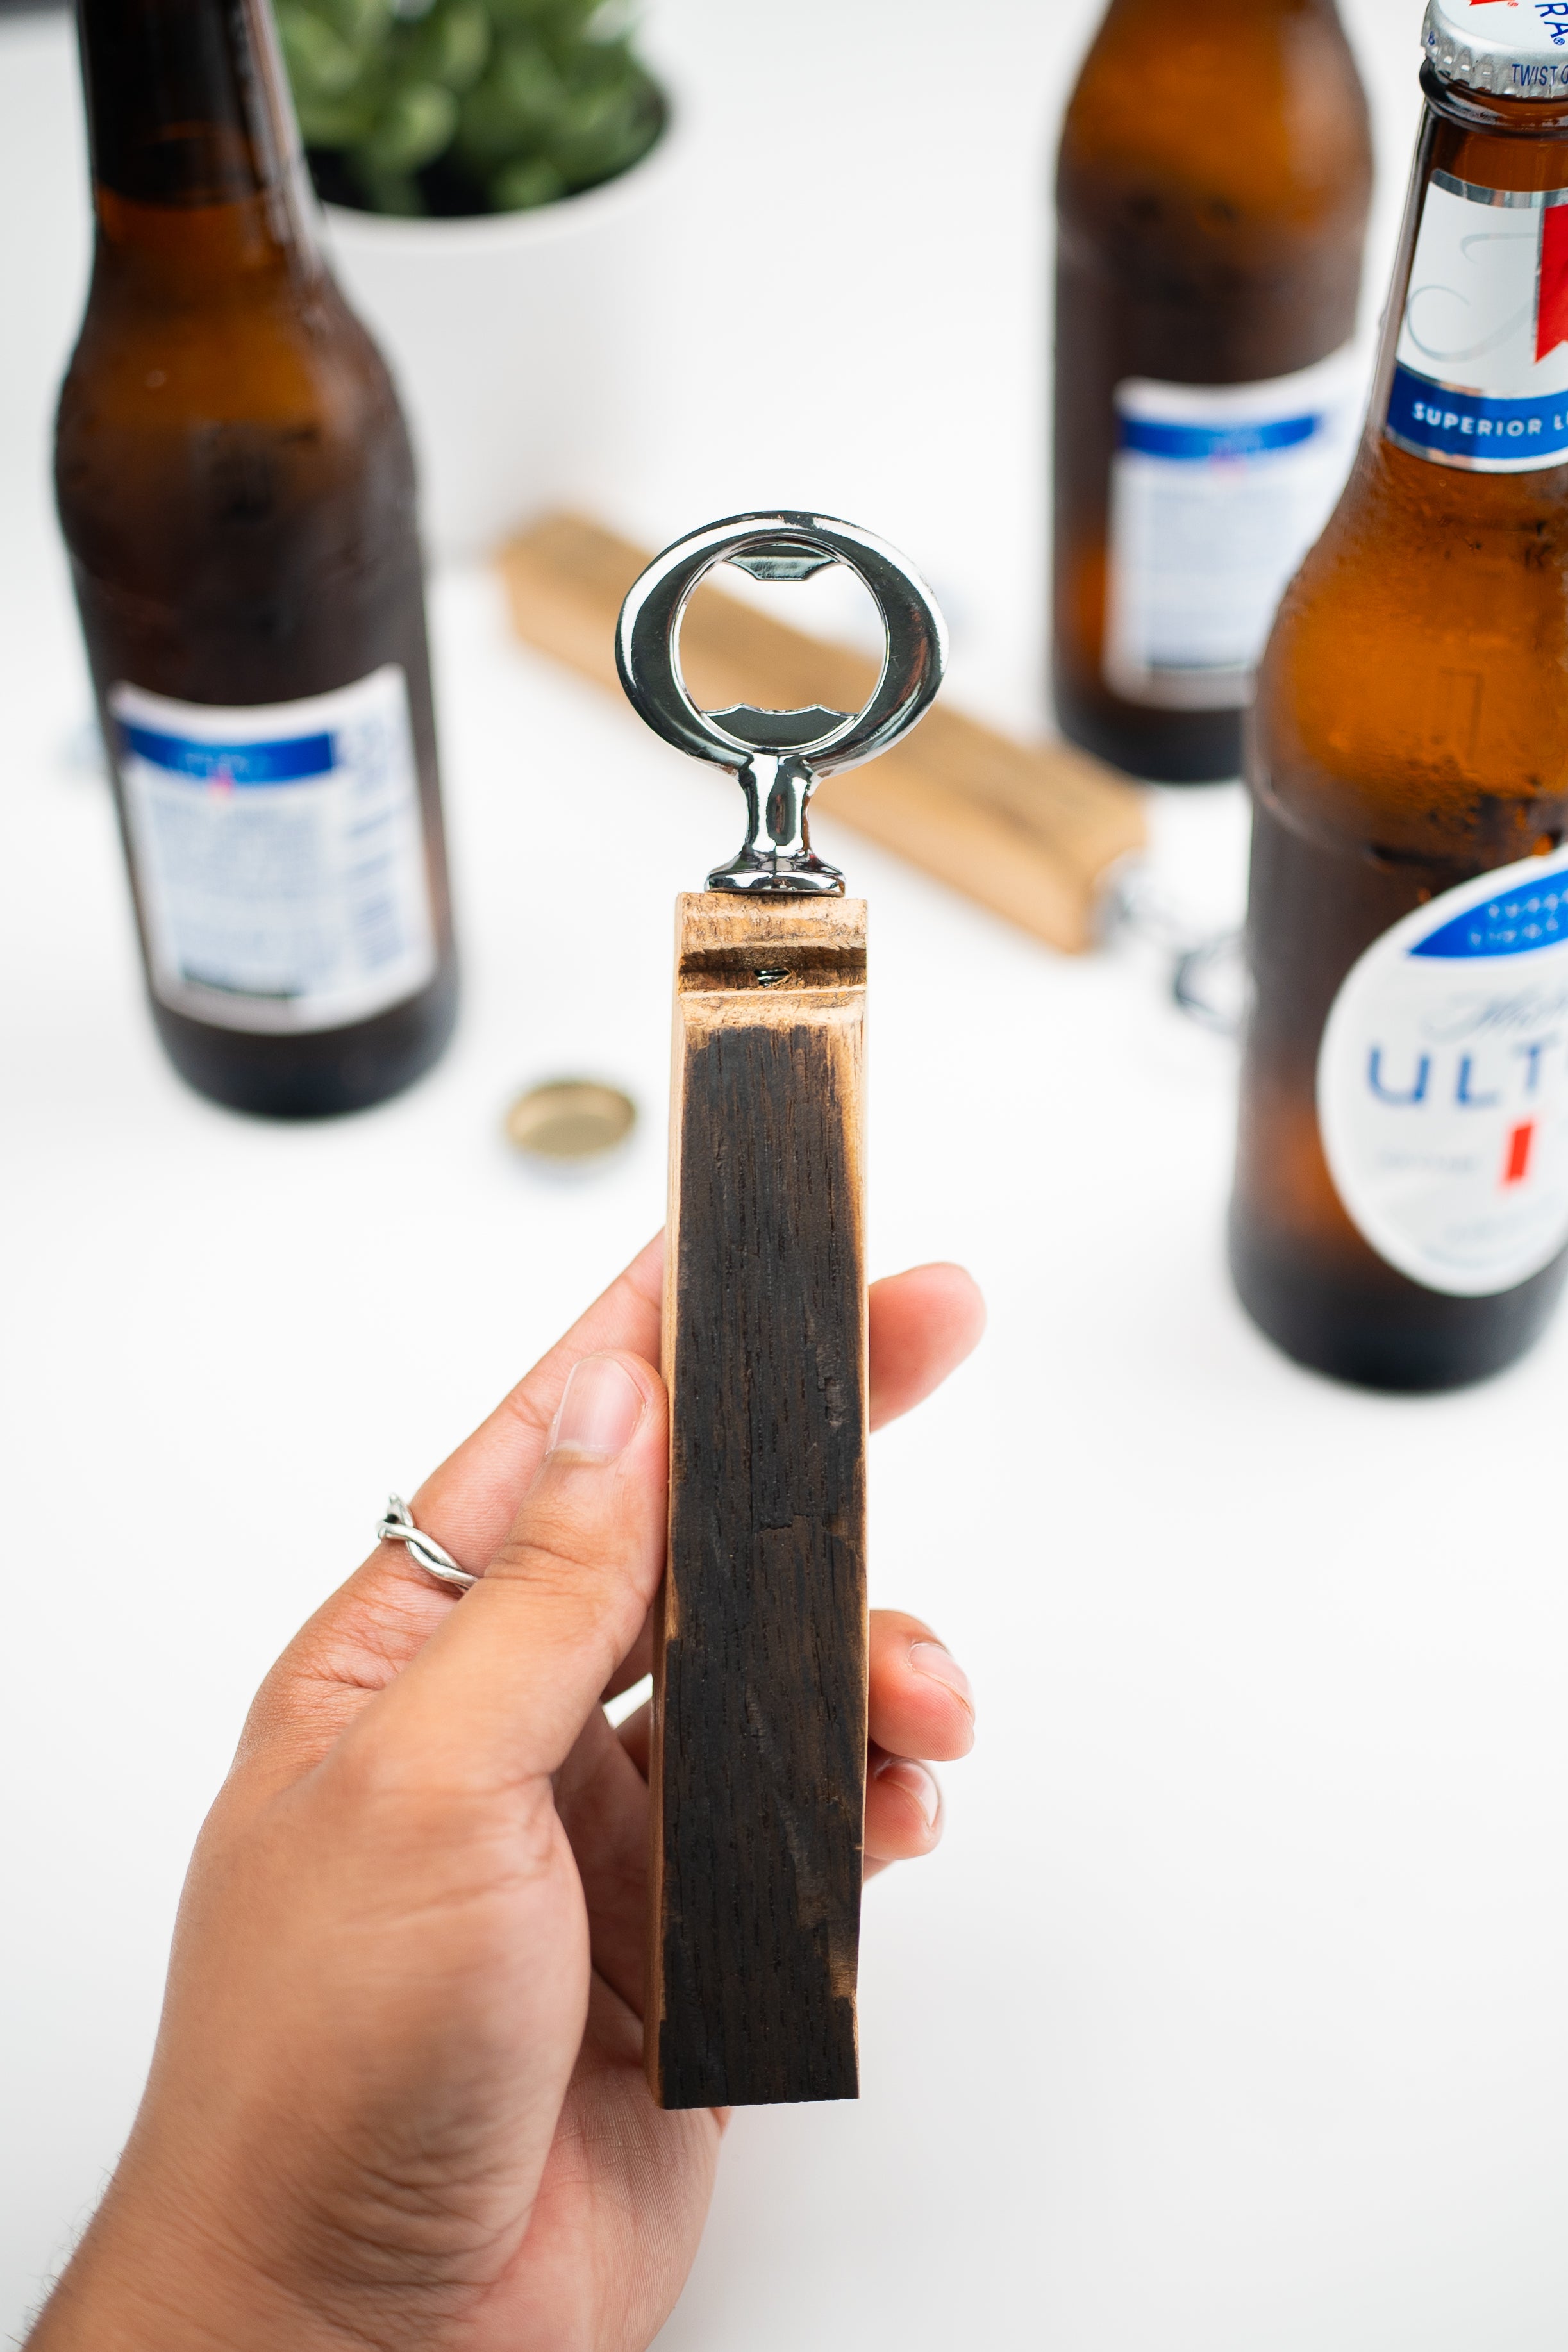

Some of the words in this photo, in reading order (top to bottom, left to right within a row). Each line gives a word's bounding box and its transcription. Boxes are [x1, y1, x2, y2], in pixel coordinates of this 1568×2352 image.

[1512, 63, 1558, 86] TWIST
[1413, 401, 1542, 437] SUPERIOR
[1554, 410, 1568, 430] L
[1366, 1030, 1568, 1109] ULT
